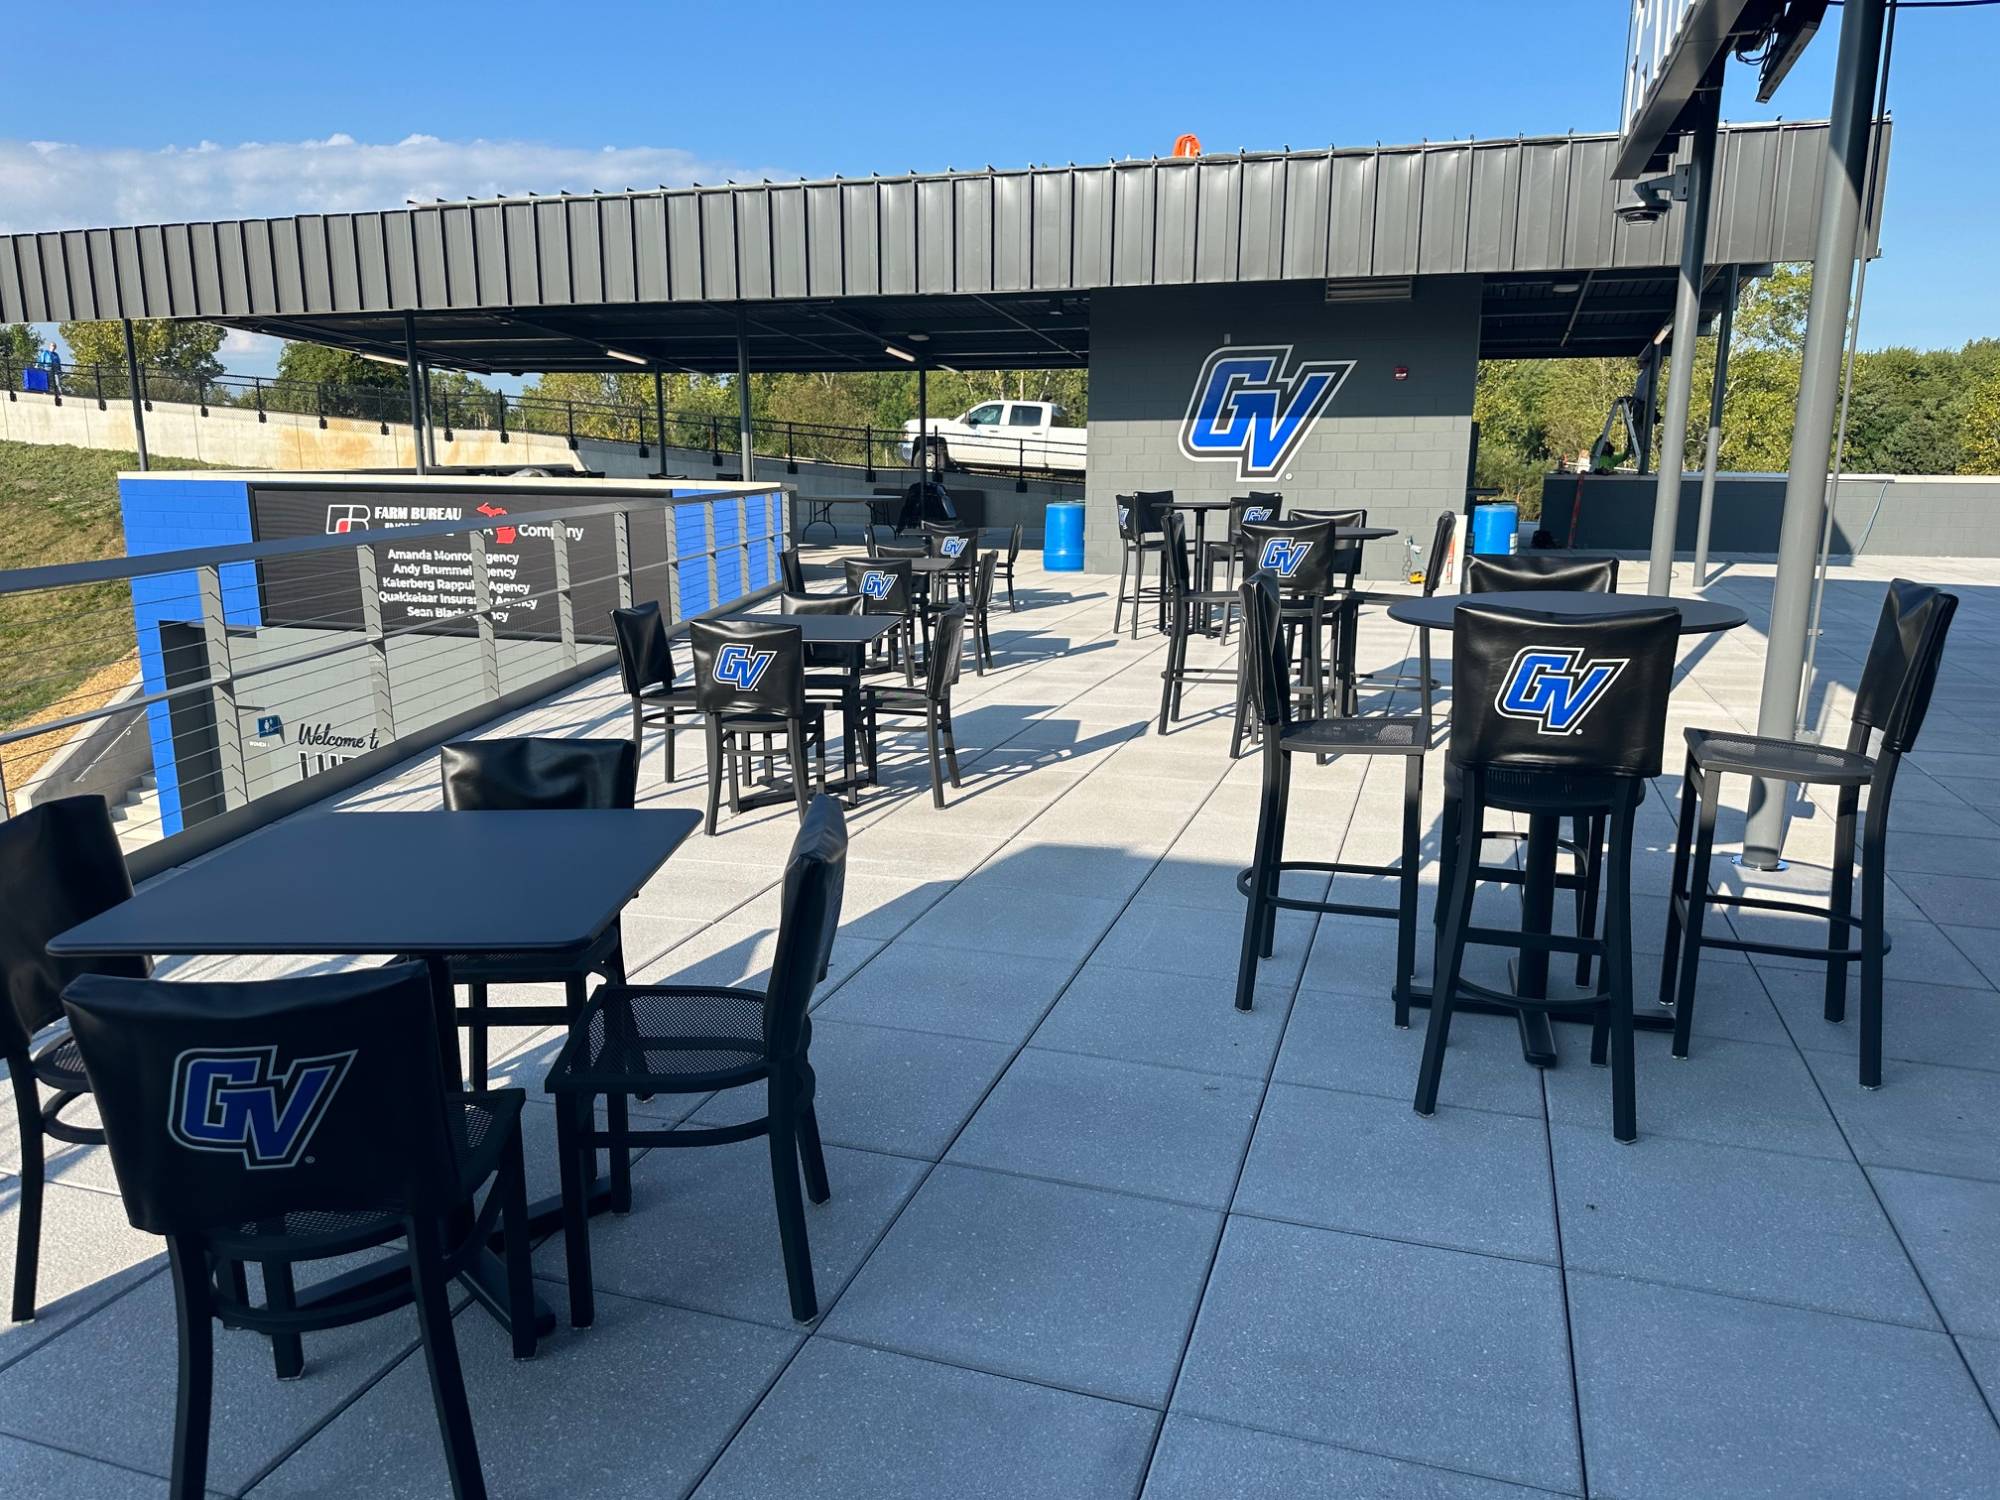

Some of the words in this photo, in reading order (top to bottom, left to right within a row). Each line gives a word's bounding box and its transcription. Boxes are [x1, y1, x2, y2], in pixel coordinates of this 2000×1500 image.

[1178, 345, 1357, 482] GV
[374, 506, 408, 520] FARM
[411, 507, 462, 521] BUREAU
[518, 524, 584, 541] Comny
[388, 549, 432, 560] Amanda
[485, 553, 520, 566] gency
[393, 564, 420, 576] Andy
[1259, 537, 1314, 577] GV
[489, 581, 530, 595] Agency
[859, 570, 898, 600] GV
[407, 606, 434, 617] Sean
[713, 643, 777, 691] GV
[1495, 645, 1631, 736] GV
[298, 723, 366, 749] Welcome
[168, 1045, 359, 1170] GV
